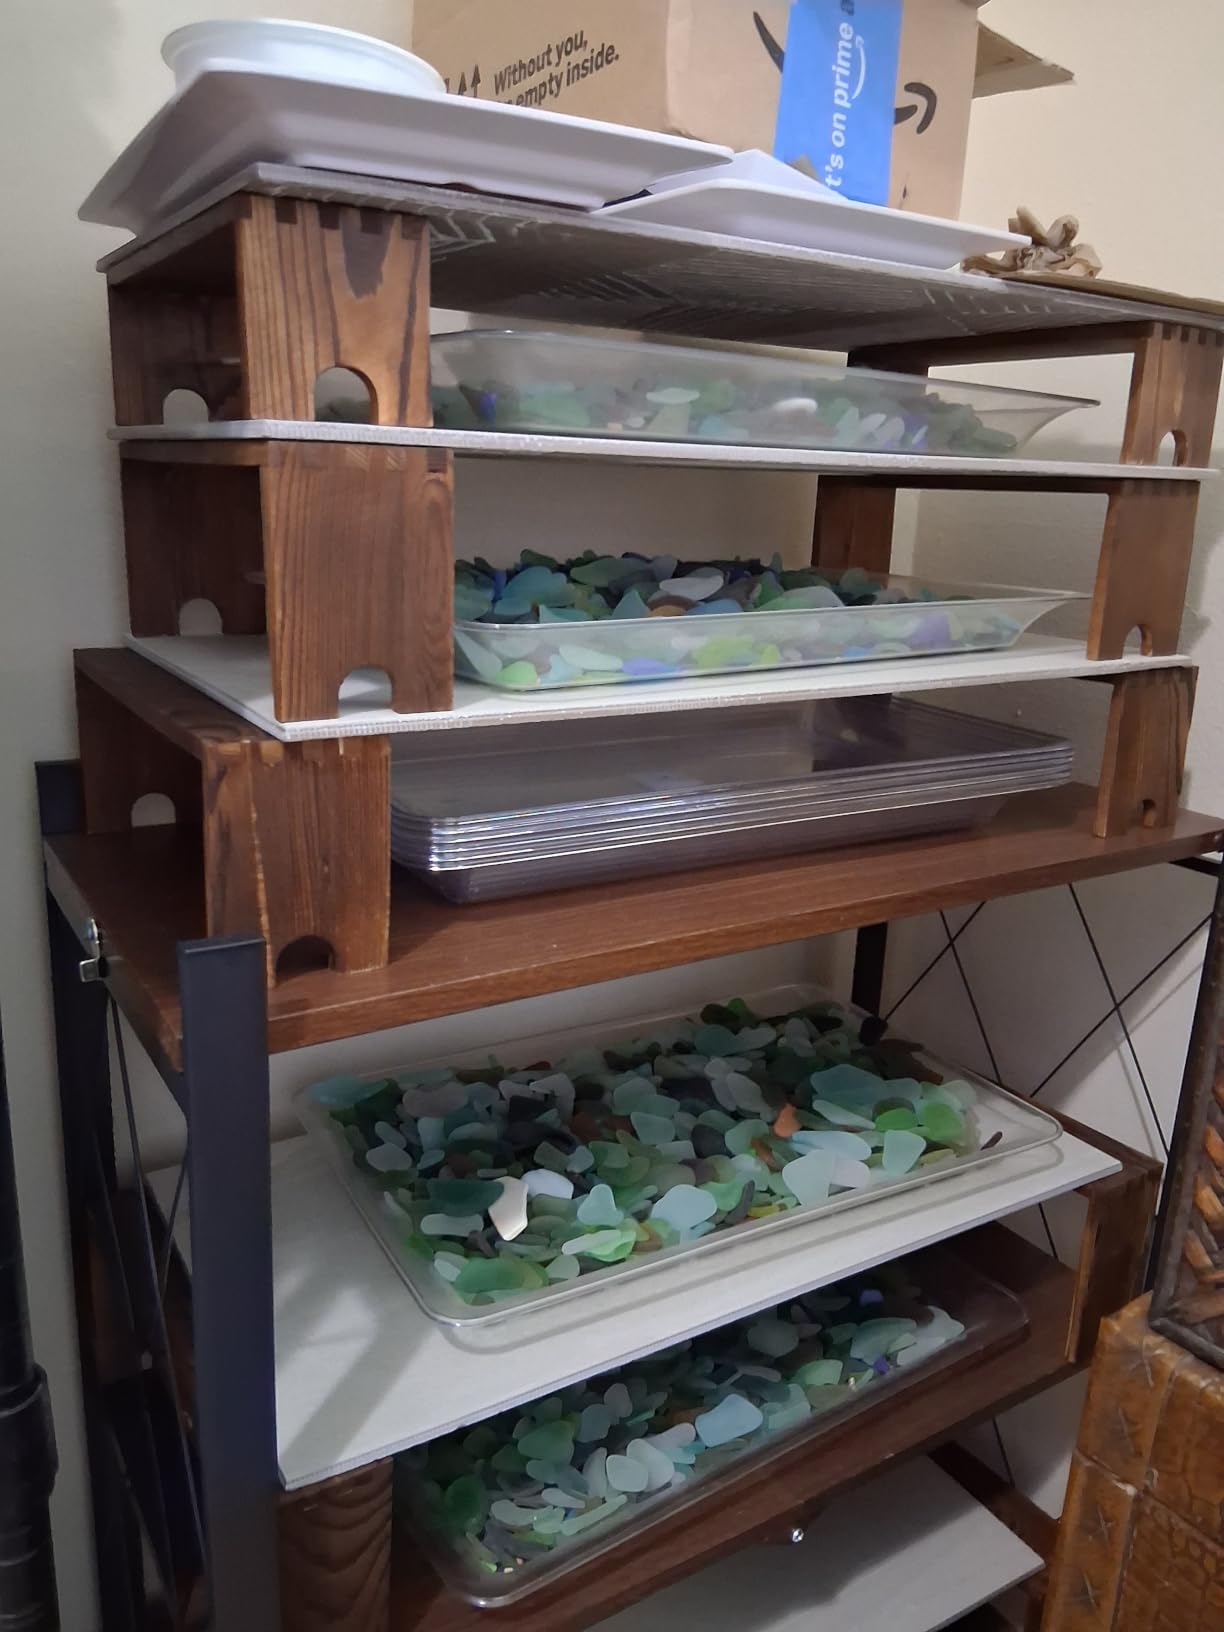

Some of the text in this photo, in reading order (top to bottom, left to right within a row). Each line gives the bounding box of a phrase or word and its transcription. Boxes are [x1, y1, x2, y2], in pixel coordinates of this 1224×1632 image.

[494, 30, 588, 95] Without you,
[514, 42, 619, 106] empty inside.
[832, 22, 854, 109] prime
[831, 115, 847, 148] on
[825, 153, 844, 188] t's
